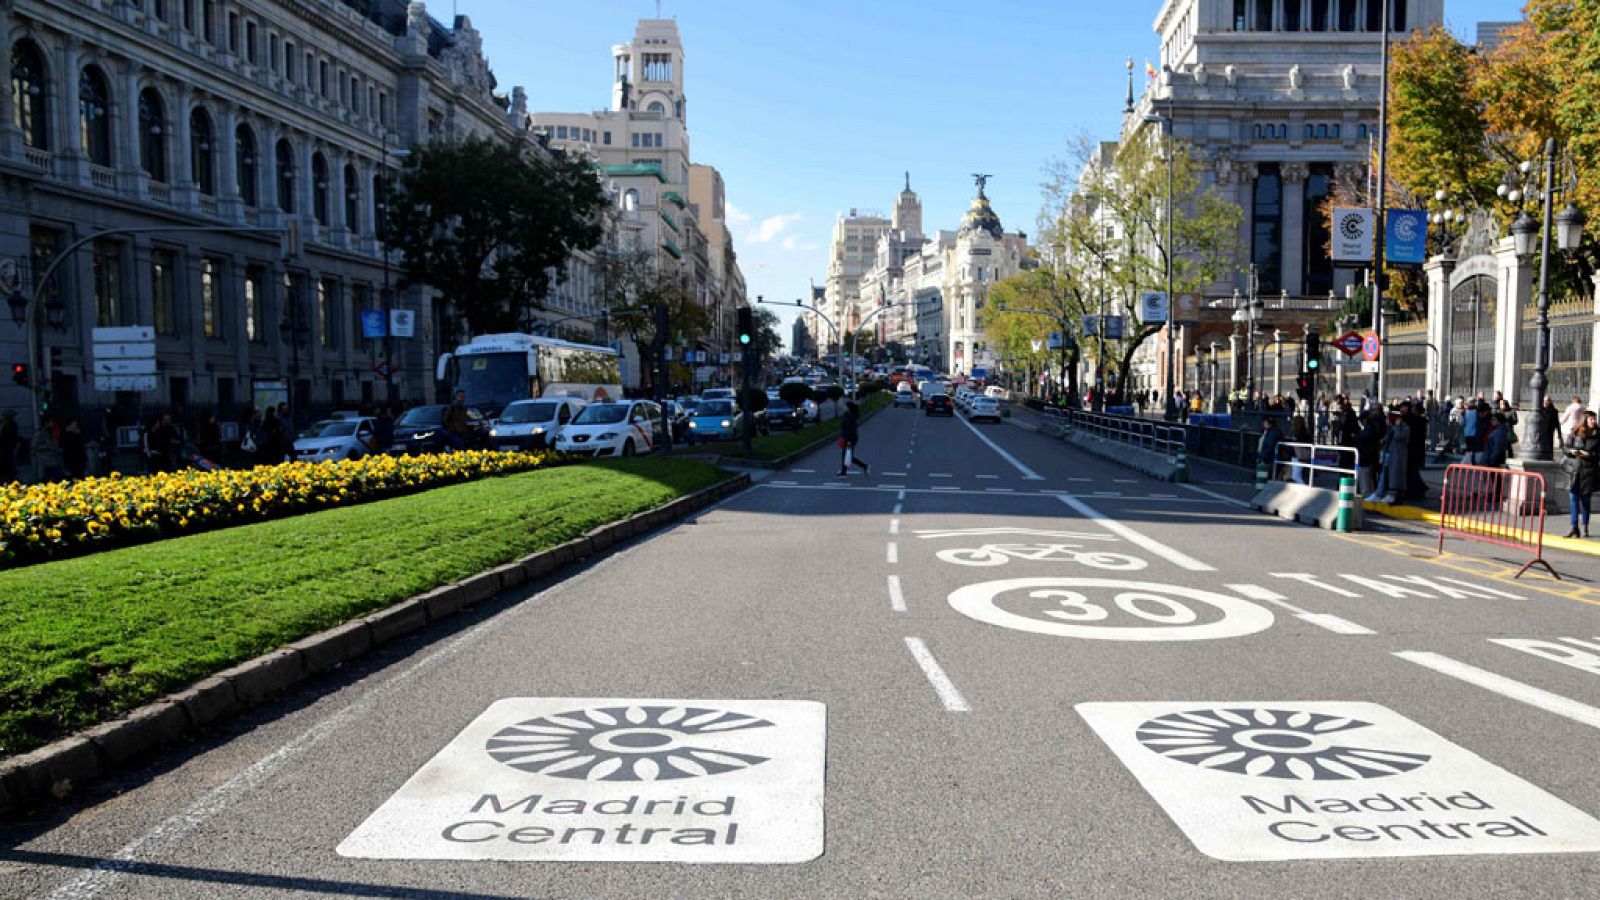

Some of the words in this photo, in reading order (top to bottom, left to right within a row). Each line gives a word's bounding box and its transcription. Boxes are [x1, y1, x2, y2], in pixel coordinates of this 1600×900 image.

[1267, 573, 1529, 600] TAXI
[1029, 589, 1197, 624] 30
[470, 794, 735, 816] Madrid
[1240, 791, 1495, 815] Madrid
[441, 820, 738, 845] Central
[1268, 816, 1548, 843] Central
